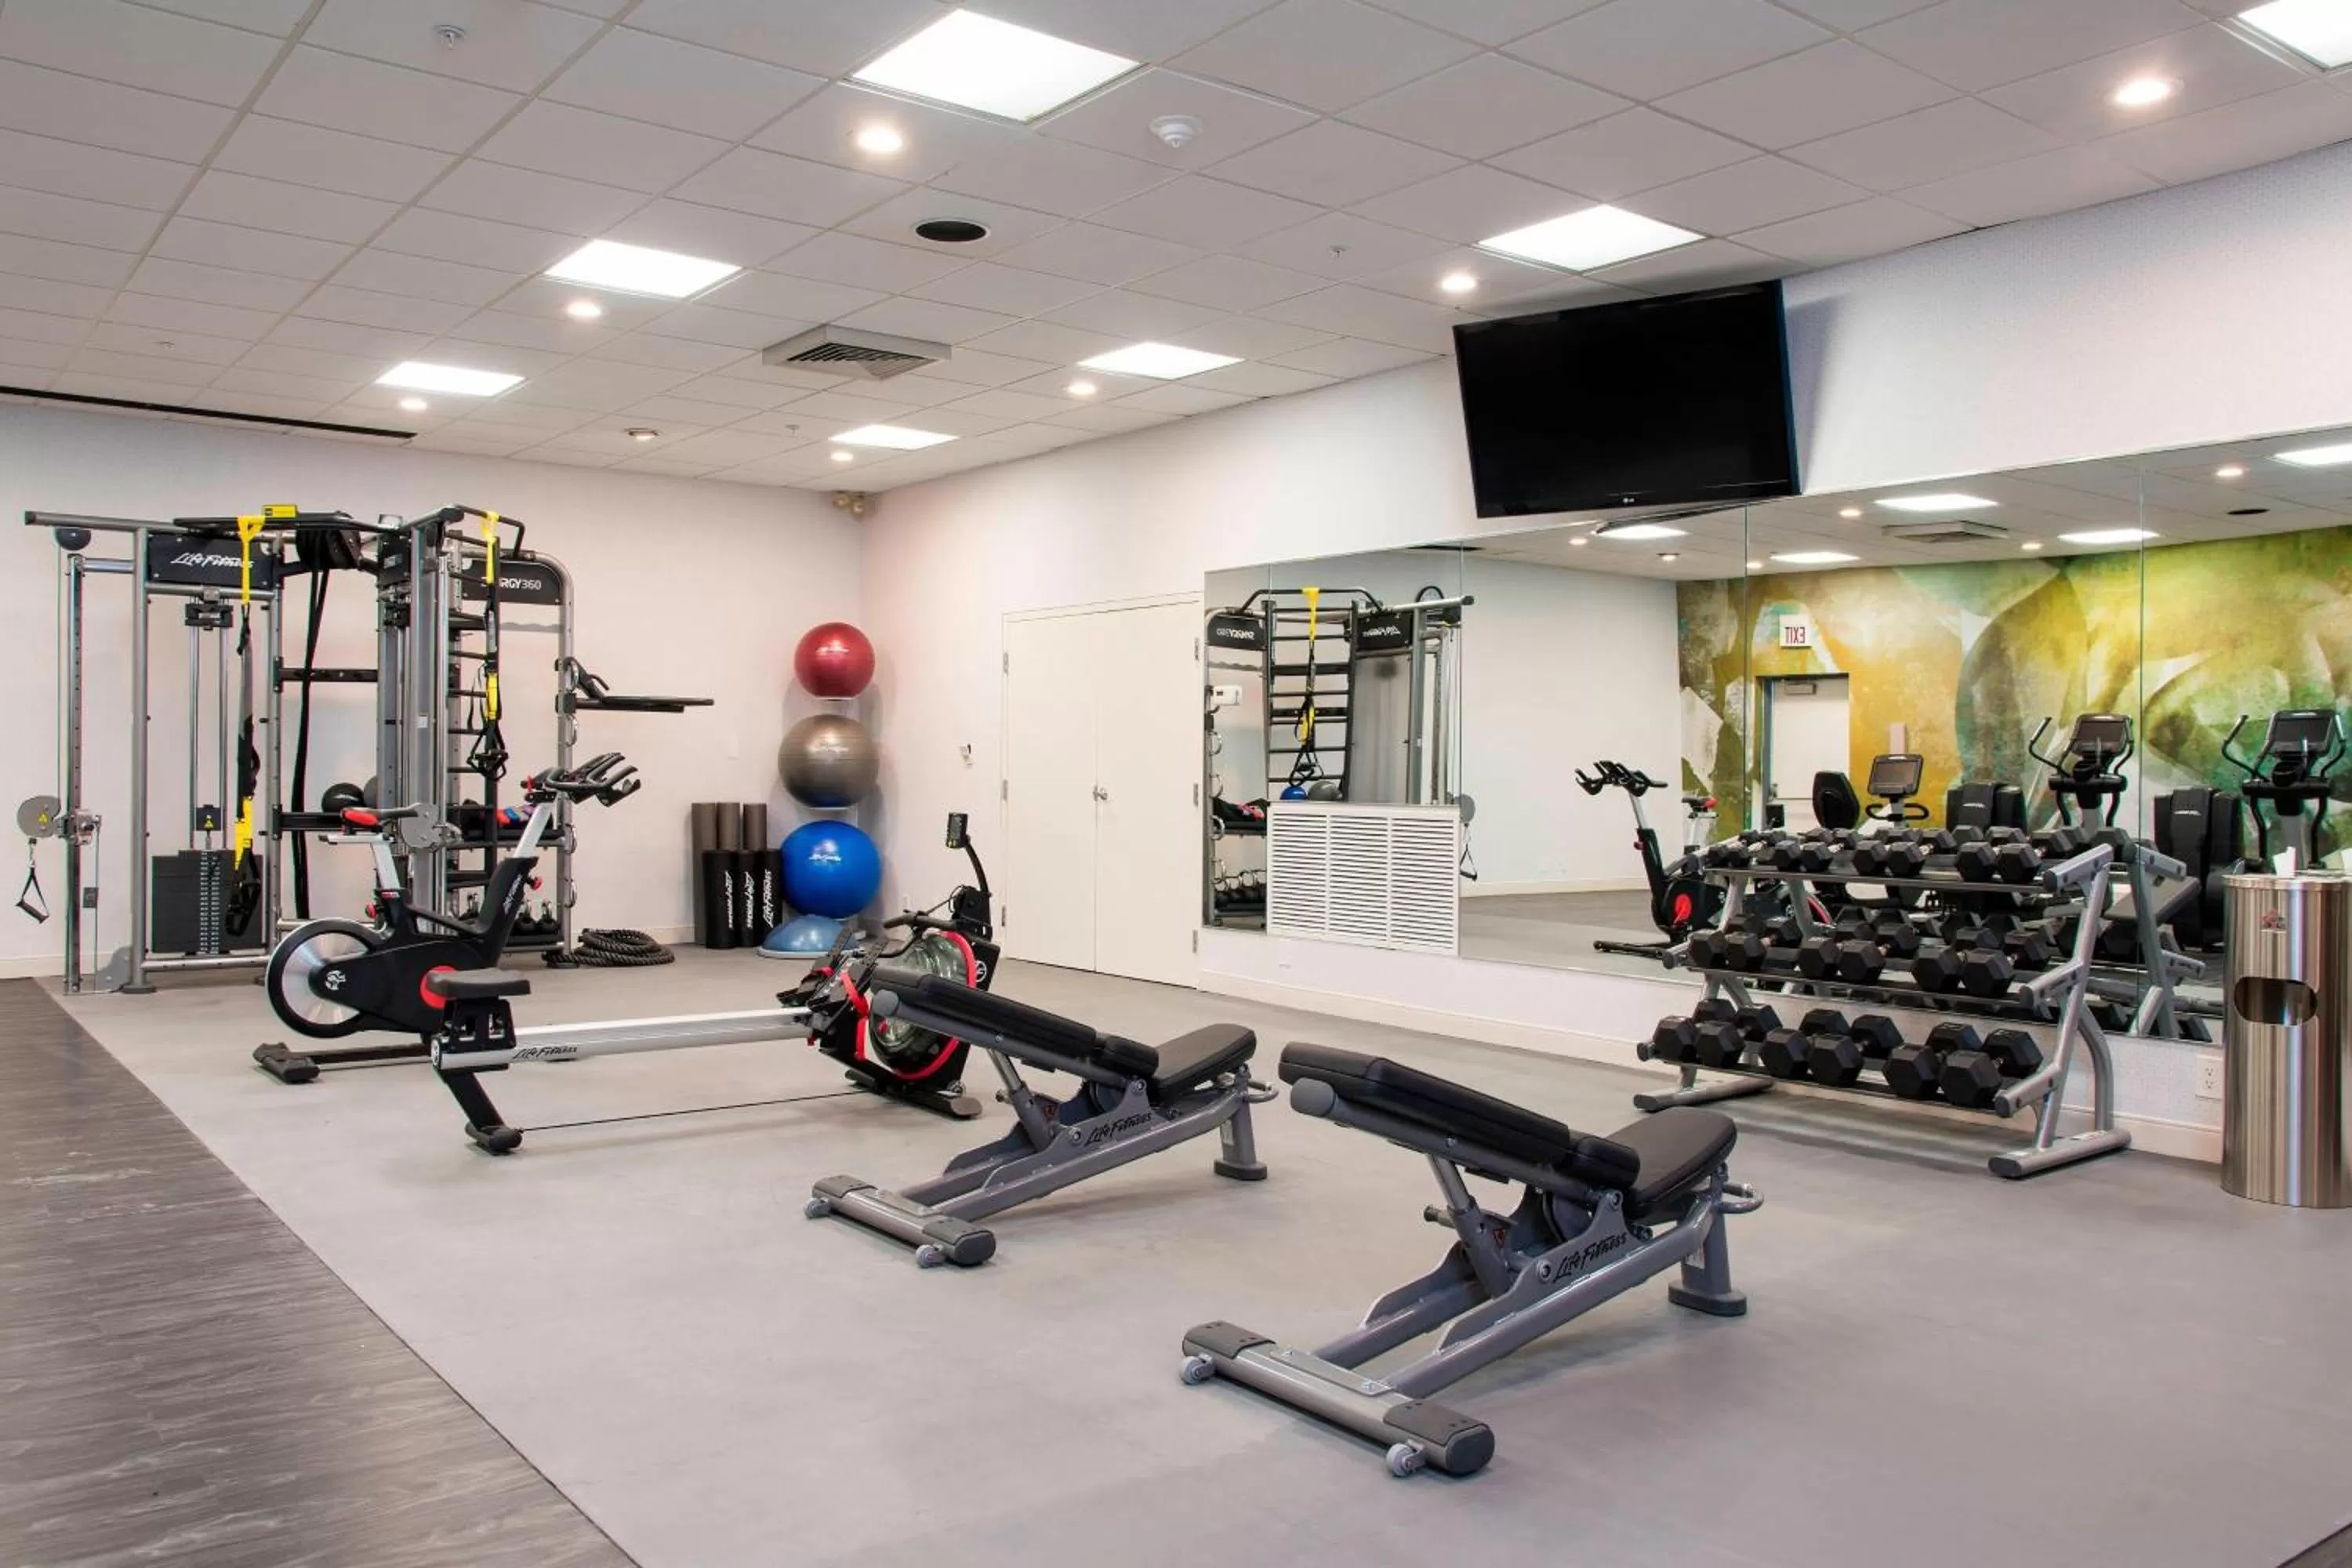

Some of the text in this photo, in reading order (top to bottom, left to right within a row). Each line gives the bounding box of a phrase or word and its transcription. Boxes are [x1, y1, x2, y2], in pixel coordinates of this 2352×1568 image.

[1084, 1112, 1152, 1146] Life Fitness
[1553, 1232, 1628, 1283] Life Fitness
